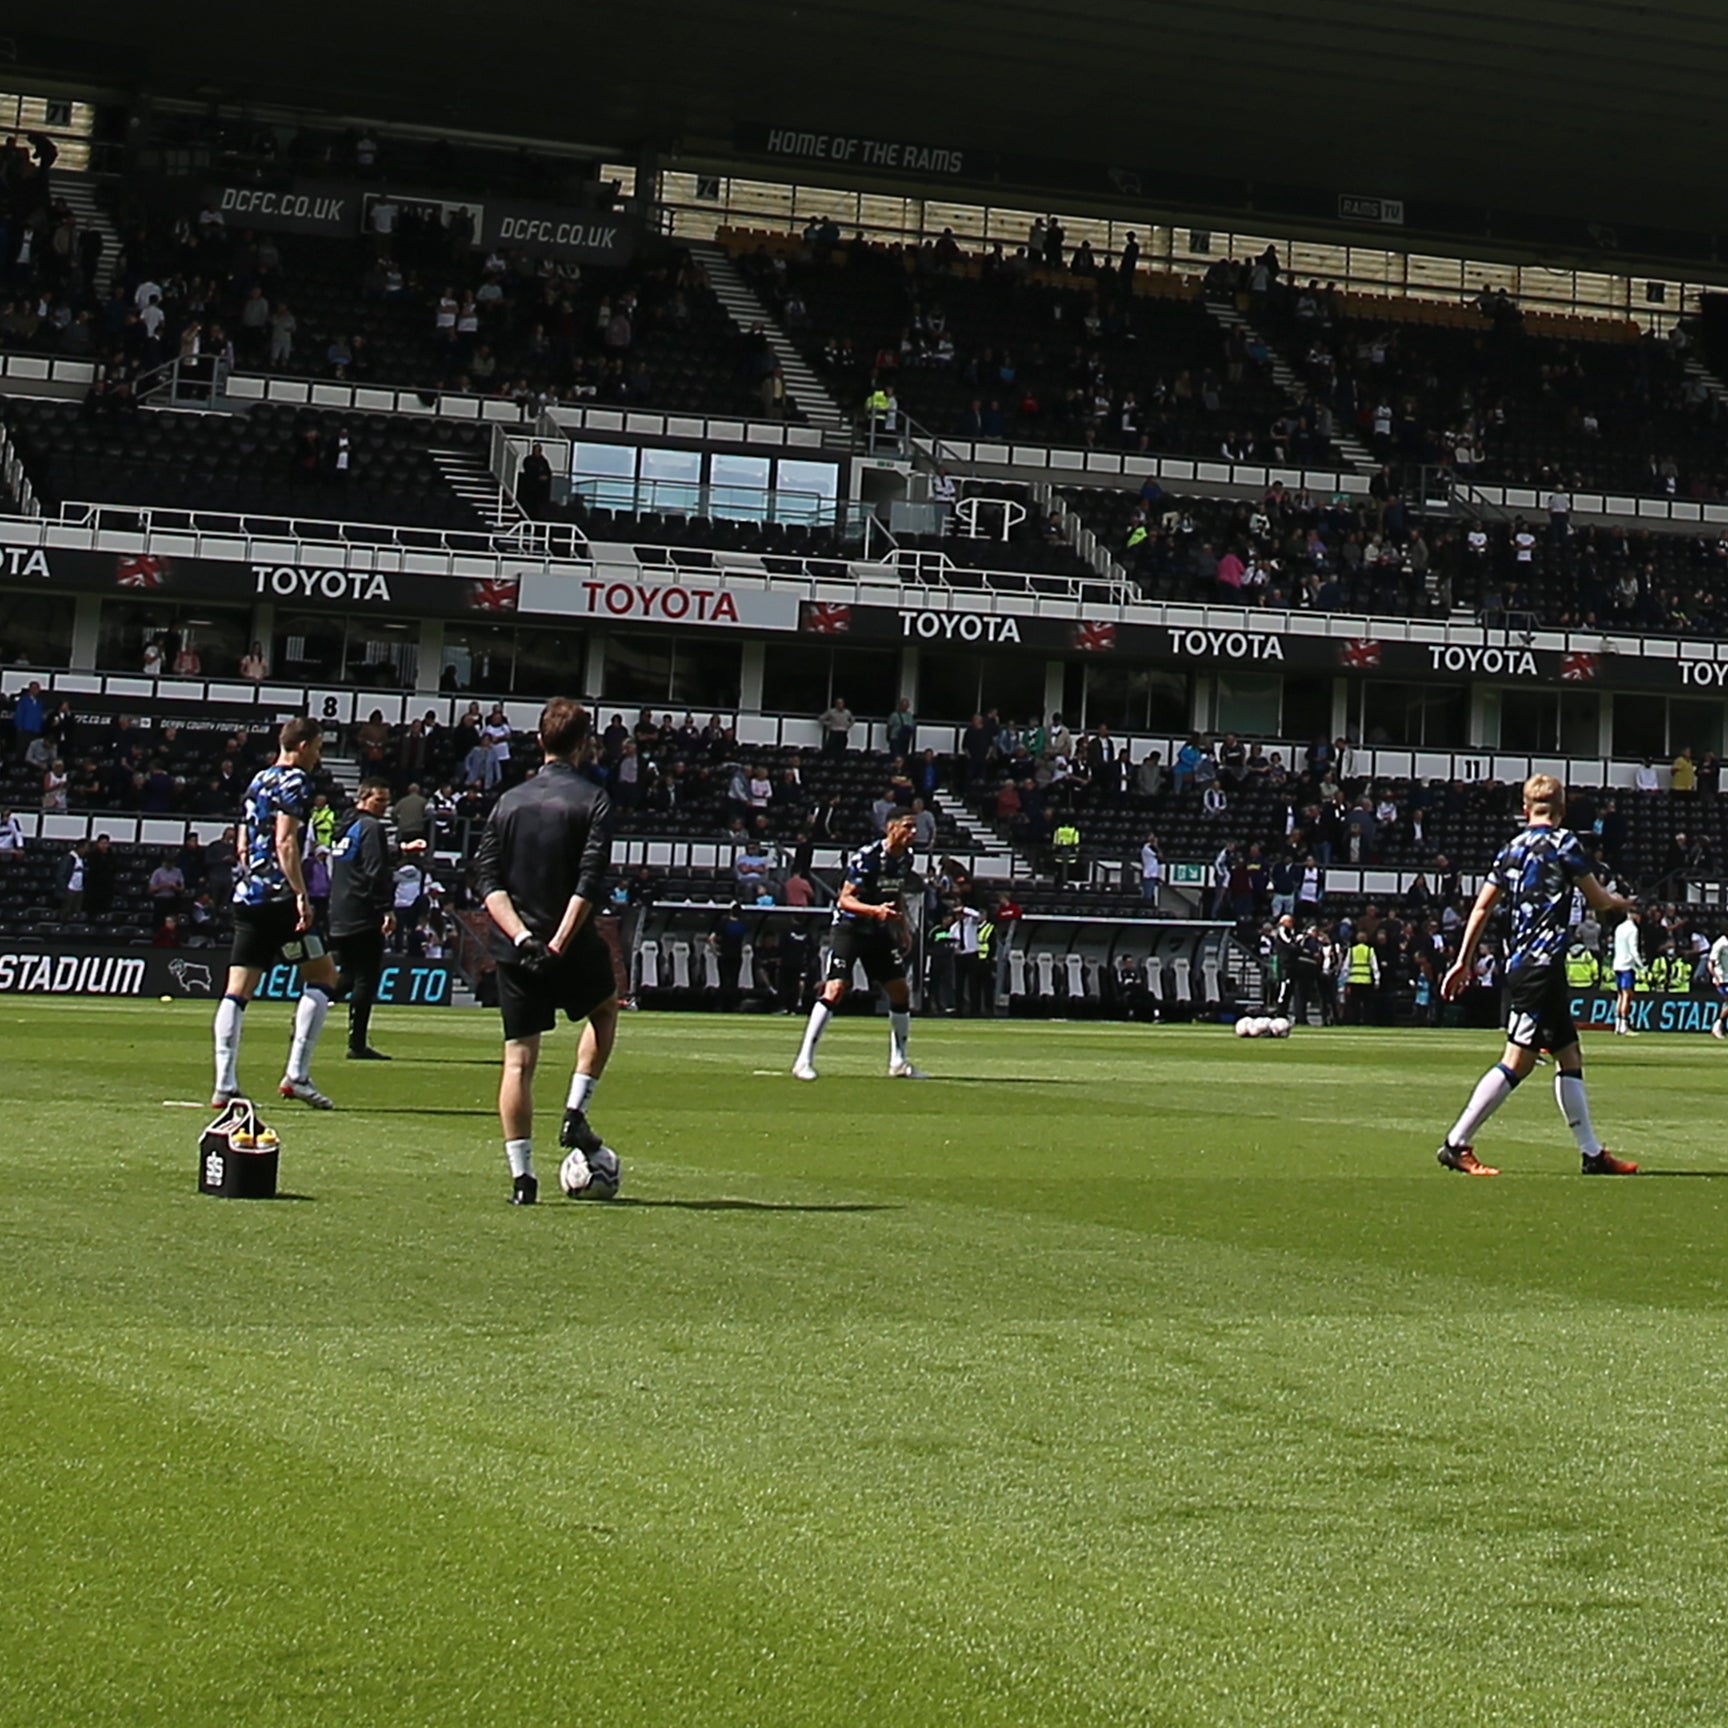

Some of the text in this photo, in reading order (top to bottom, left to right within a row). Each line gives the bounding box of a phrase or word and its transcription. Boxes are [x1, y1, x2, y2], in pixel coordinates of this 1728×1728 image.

[767, 129, 964, 173] HOME OF THE RAMS
[221, 188, 344, 221] DCFC.CO.UK
[1342, 199, 1401, 219] RAMS TV
[500, 217, 617, 249] DCFC.CO.UK
[252, 566, 390, 601] TOYOTA
[581, 581, 740, 623] TOYOTA
[898, 611, 1021, 643] TOYOTA
[1168, 629, 1284, 661] TOYOTA
[1428, 645, 1538, 675] TOYOTA
[322, 696, 337, 718] 8
[1464, 760, 1480, 780] 11
[0, 954, 146, 995] STADIUM
[409, 969, 448, 1002] TO
